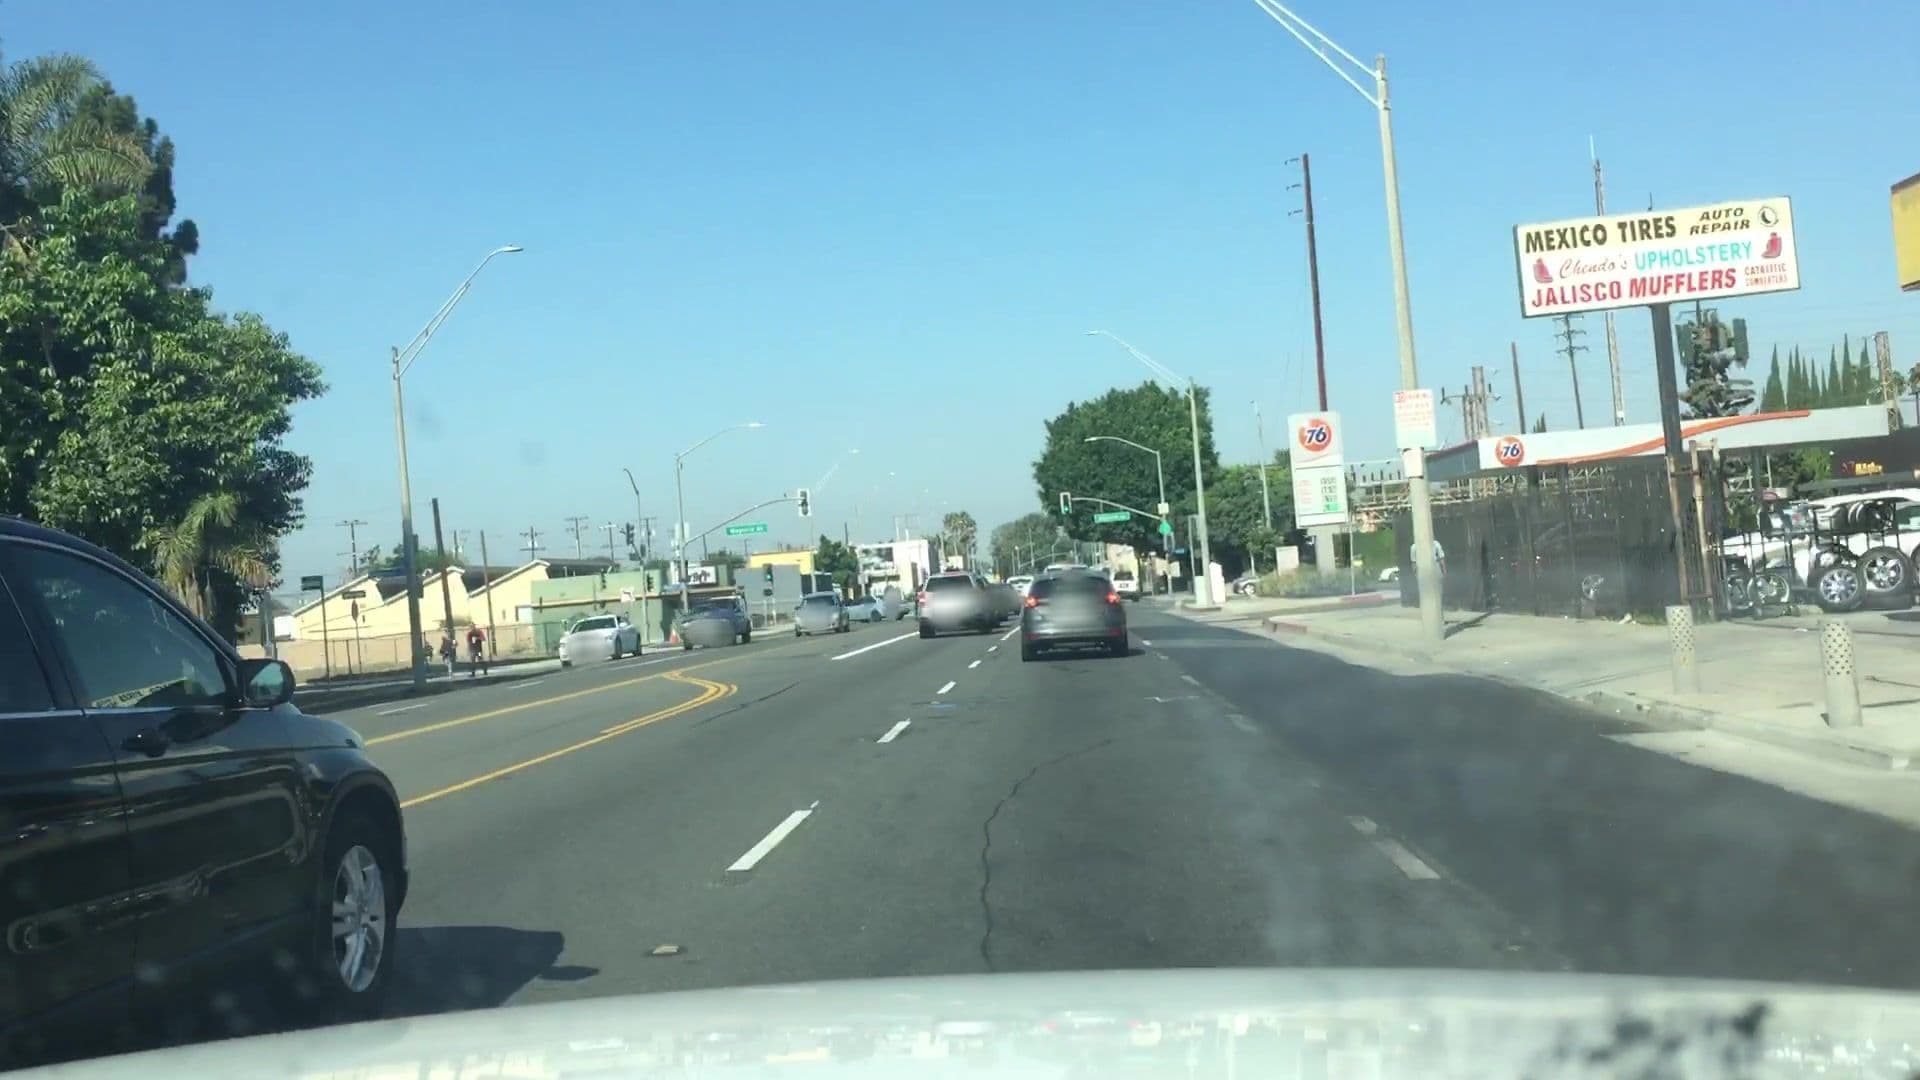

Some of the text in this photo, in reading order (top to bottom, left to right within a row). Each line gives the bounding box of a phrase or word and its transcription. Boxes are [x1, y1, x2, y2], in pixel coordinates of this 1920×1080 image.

[1699, 207, 1744, 222] AUTO
[1525, 216, 1676, 254] MEXICO TIRES
[1689, 219, 1751, 236] REPAIR
[1559, 241, 1752, 279] Chendo's UPHOLSTERY
[1531, 267, 1737, 308] JALISCO MUFFLERS
[1306, 426, 1327, 444] 76
[1503, 444, 1520, 458] 76
